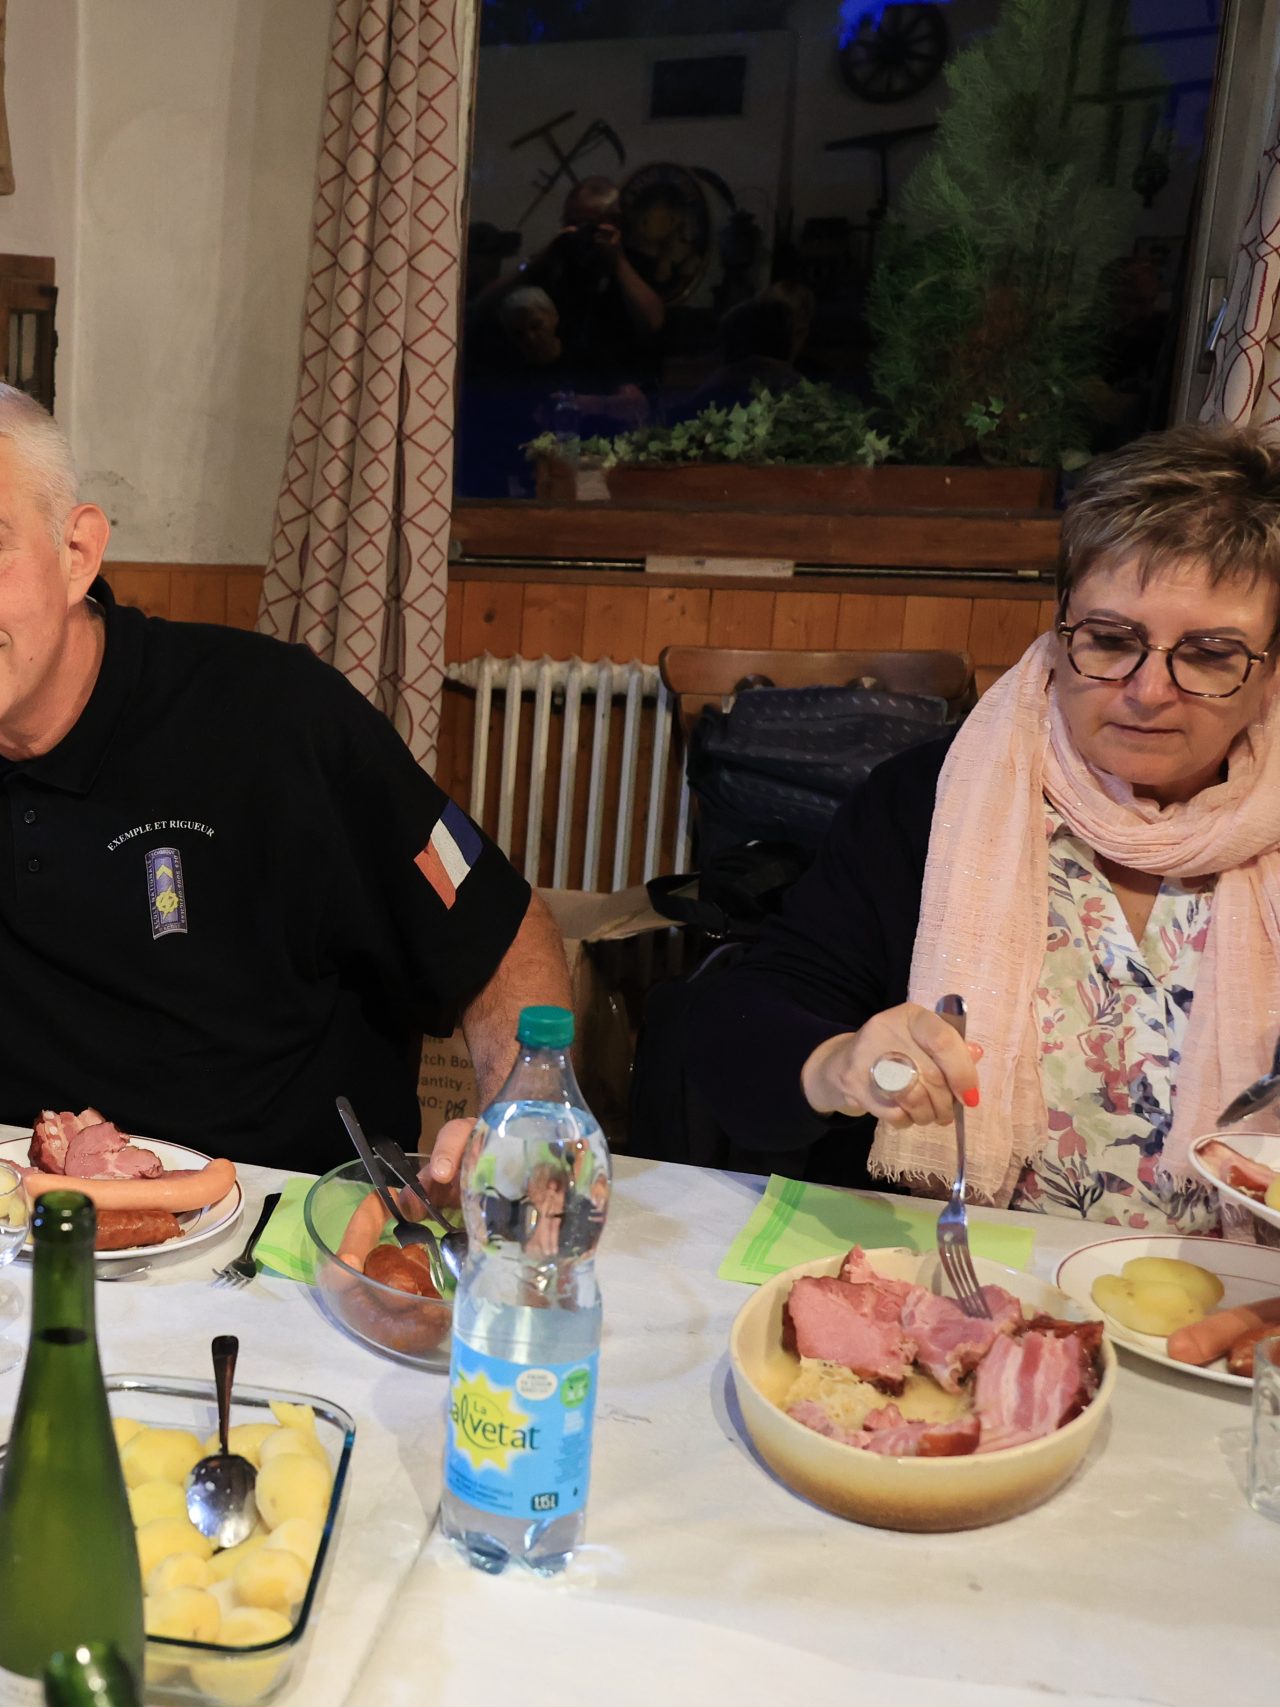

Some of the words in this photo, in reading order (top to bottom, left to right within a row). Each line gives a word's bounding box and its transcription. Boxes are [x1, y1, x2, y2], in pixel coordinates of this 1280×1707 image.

[107, 824, 153, 852] EXEMPLE
[154, 821, 168, 830] ET
[169, 820, 215, 837] RIGUEUR
[421, 1054, 445, 1067] tch
[474, 1402, 487, 1415] La
[450, 1394, 541, 1450] alvetat
